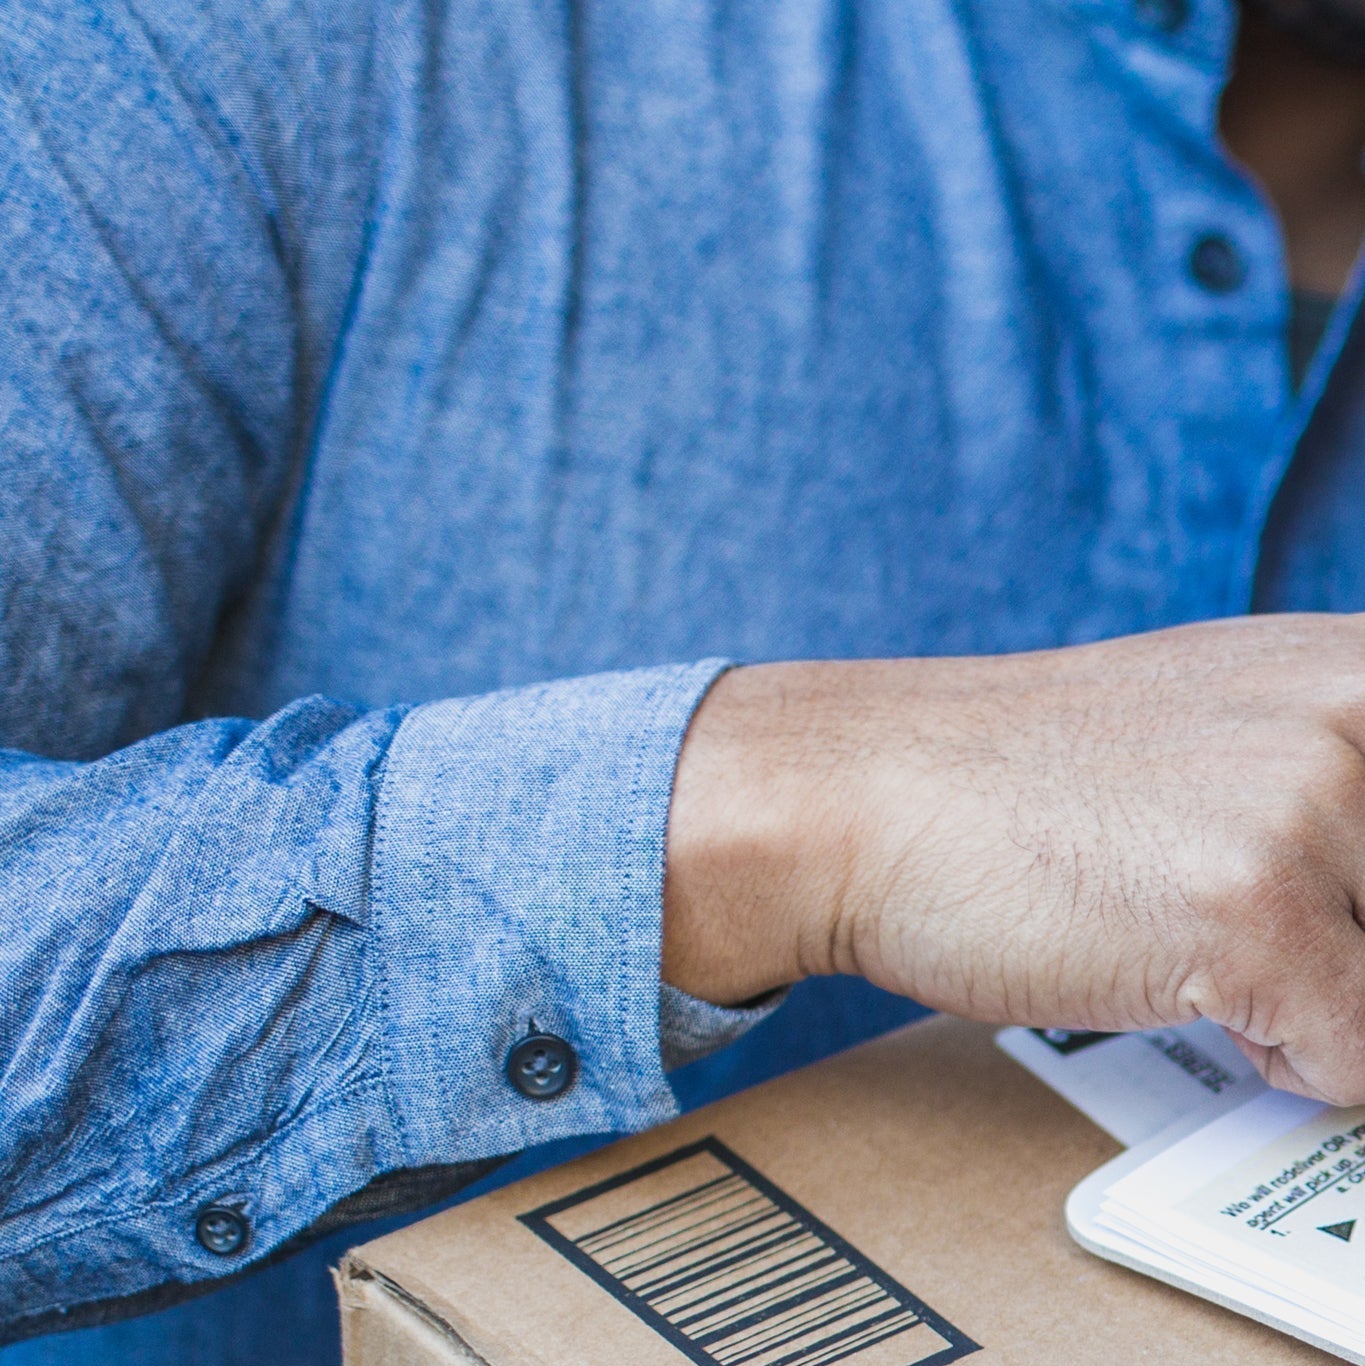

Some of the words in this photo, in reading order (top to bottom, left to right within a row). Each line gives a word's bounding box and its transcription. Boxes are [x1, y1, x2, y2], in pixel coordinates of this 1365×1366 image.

[1220, 1201, 1251, 1217] We
[1246, 1185, 1274, 1202] will
[1268, 1149, 1328, 1188] redeliver
[1321, 1135, 1351, 1152] OR
